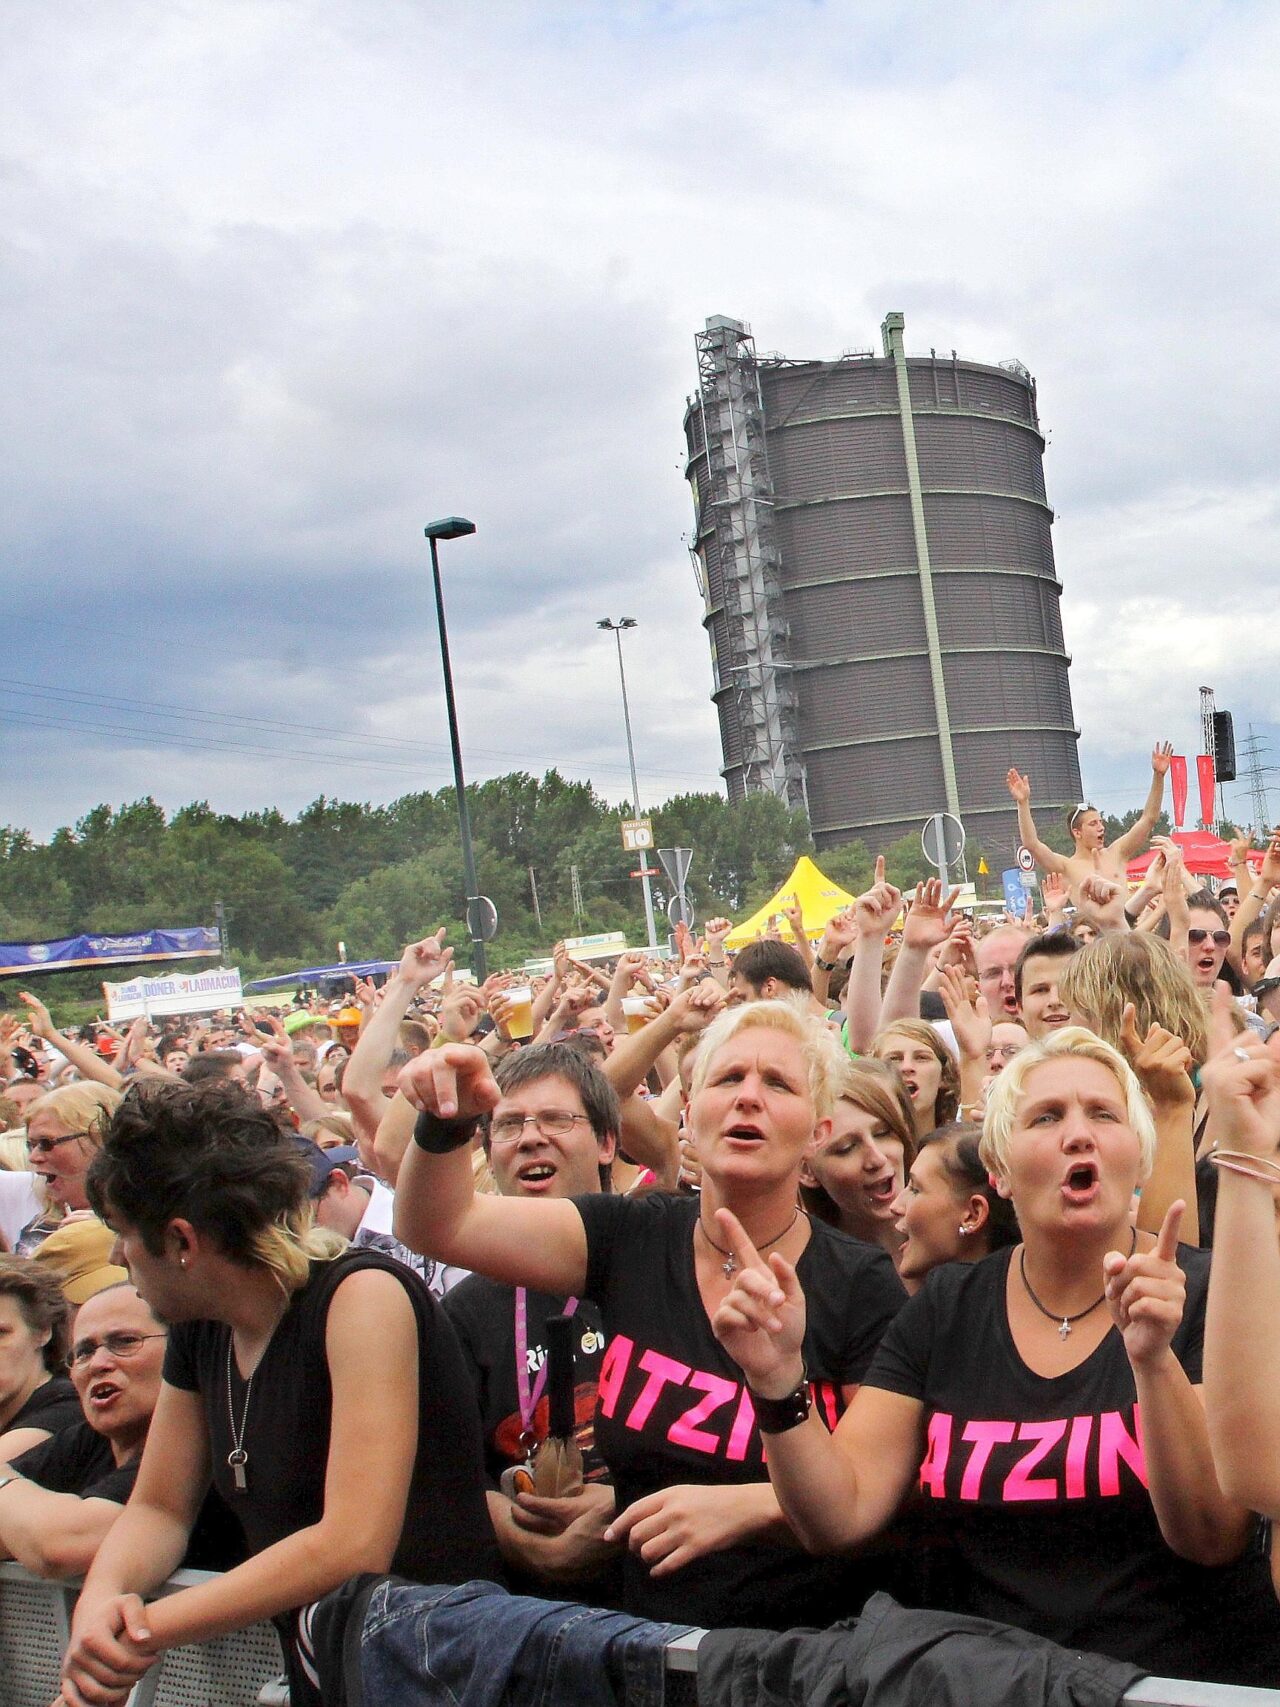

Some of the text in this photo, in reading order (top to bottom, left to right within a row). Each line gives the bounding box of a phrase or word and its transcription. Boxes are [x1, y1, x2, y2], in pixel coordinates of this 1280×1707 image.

[624, 827, 651, 848] 10
[144, 975, 240, 997] DÖNER LAHMACUN
[919, 1402, 1150, 1501] ATZIN
